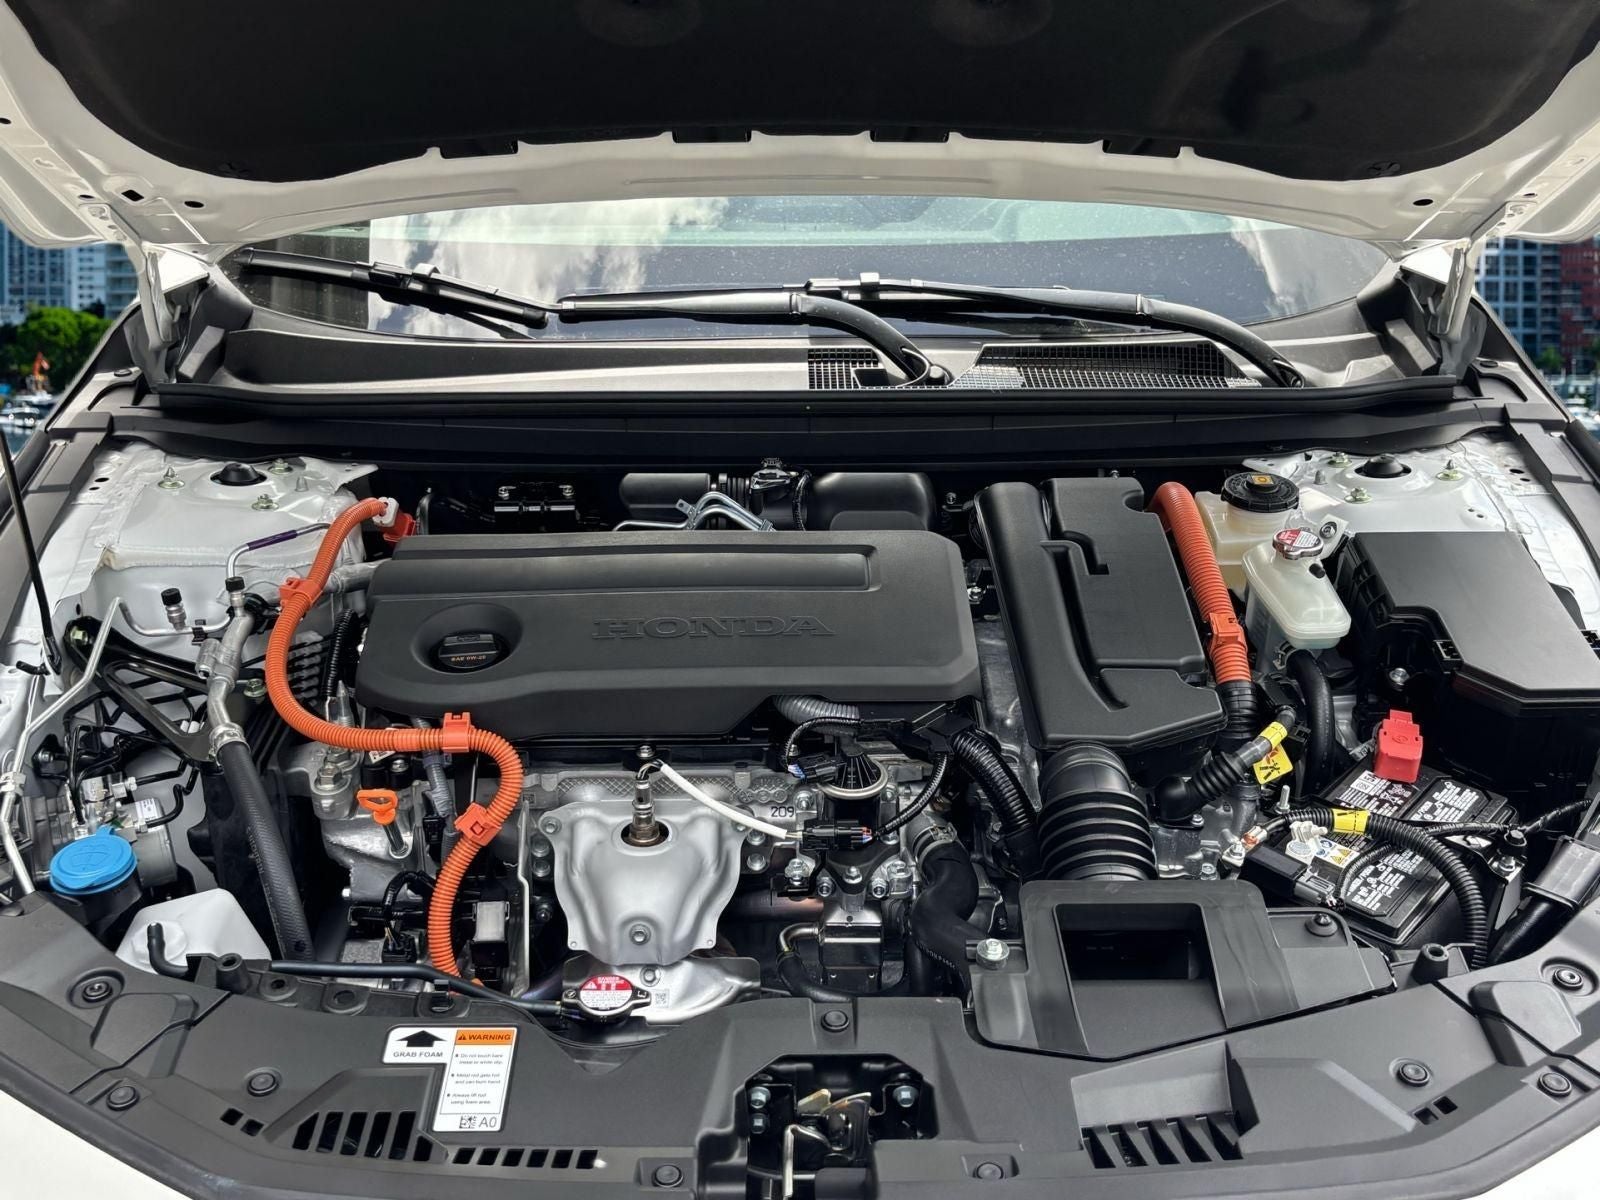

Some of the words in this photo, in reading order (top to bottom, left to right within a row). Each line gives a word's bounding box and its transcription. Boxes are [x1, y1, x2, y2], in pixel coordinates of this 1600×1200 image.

[592, 616, 837, 639] HONDA
[771, 806, 794, 818] 209
[478, 1116, 497, 1128] A0
